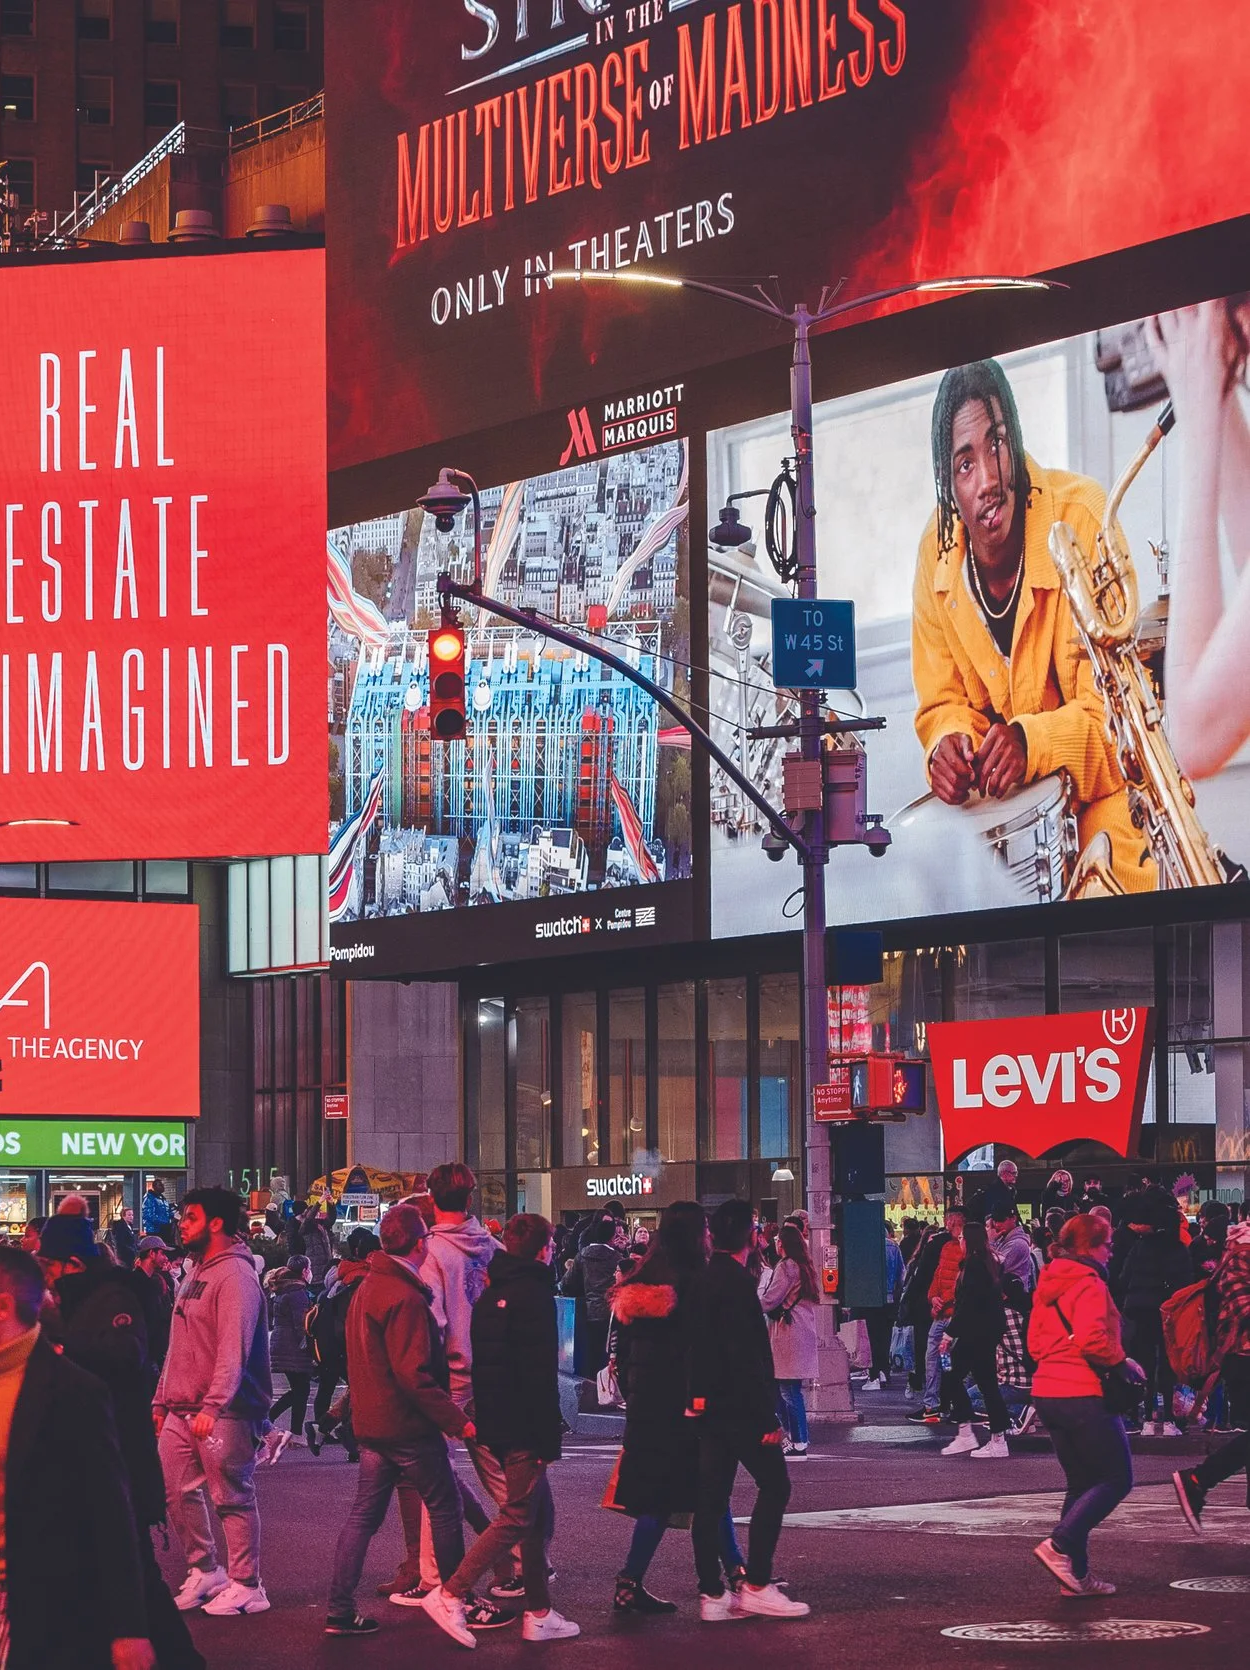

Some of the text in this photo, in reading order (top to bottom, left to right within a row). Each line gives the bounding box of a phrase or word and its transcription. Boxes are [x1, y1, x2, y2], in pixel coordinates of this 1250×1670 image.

[595, 15, 615, 46] IN
[626, 0, 663, 34] THE
[396, 0, 907, 249] MULTIVERSE OF MADNESS
[430, 192, 735, 325] ONLY IN THEATERS
[39, 346, 174, 472] REAL
[604, 383, 684, 422] MARRIOTT
[604, 411, 674, 447] MARQUIS
[5, 494, 209, 624] ESTATE
[803, 610, 823, 627] TO
[784, 634, 844, 652] W 45 St
[606, 919, 632, 931] Pompidou
[614, 908, 632, 919] Centre
[535, 915, 583, 938] swatch
[330, 944, 375, 963] Pompidou
[816, 1088, 826, 1096] NO
[817, 1096, 842, 1105] Anytime
[62, 1132, 126, 1156] NEW
[131, 1132, 185, 1156] YOR
[586, 1173, 644, 1196] swatch
